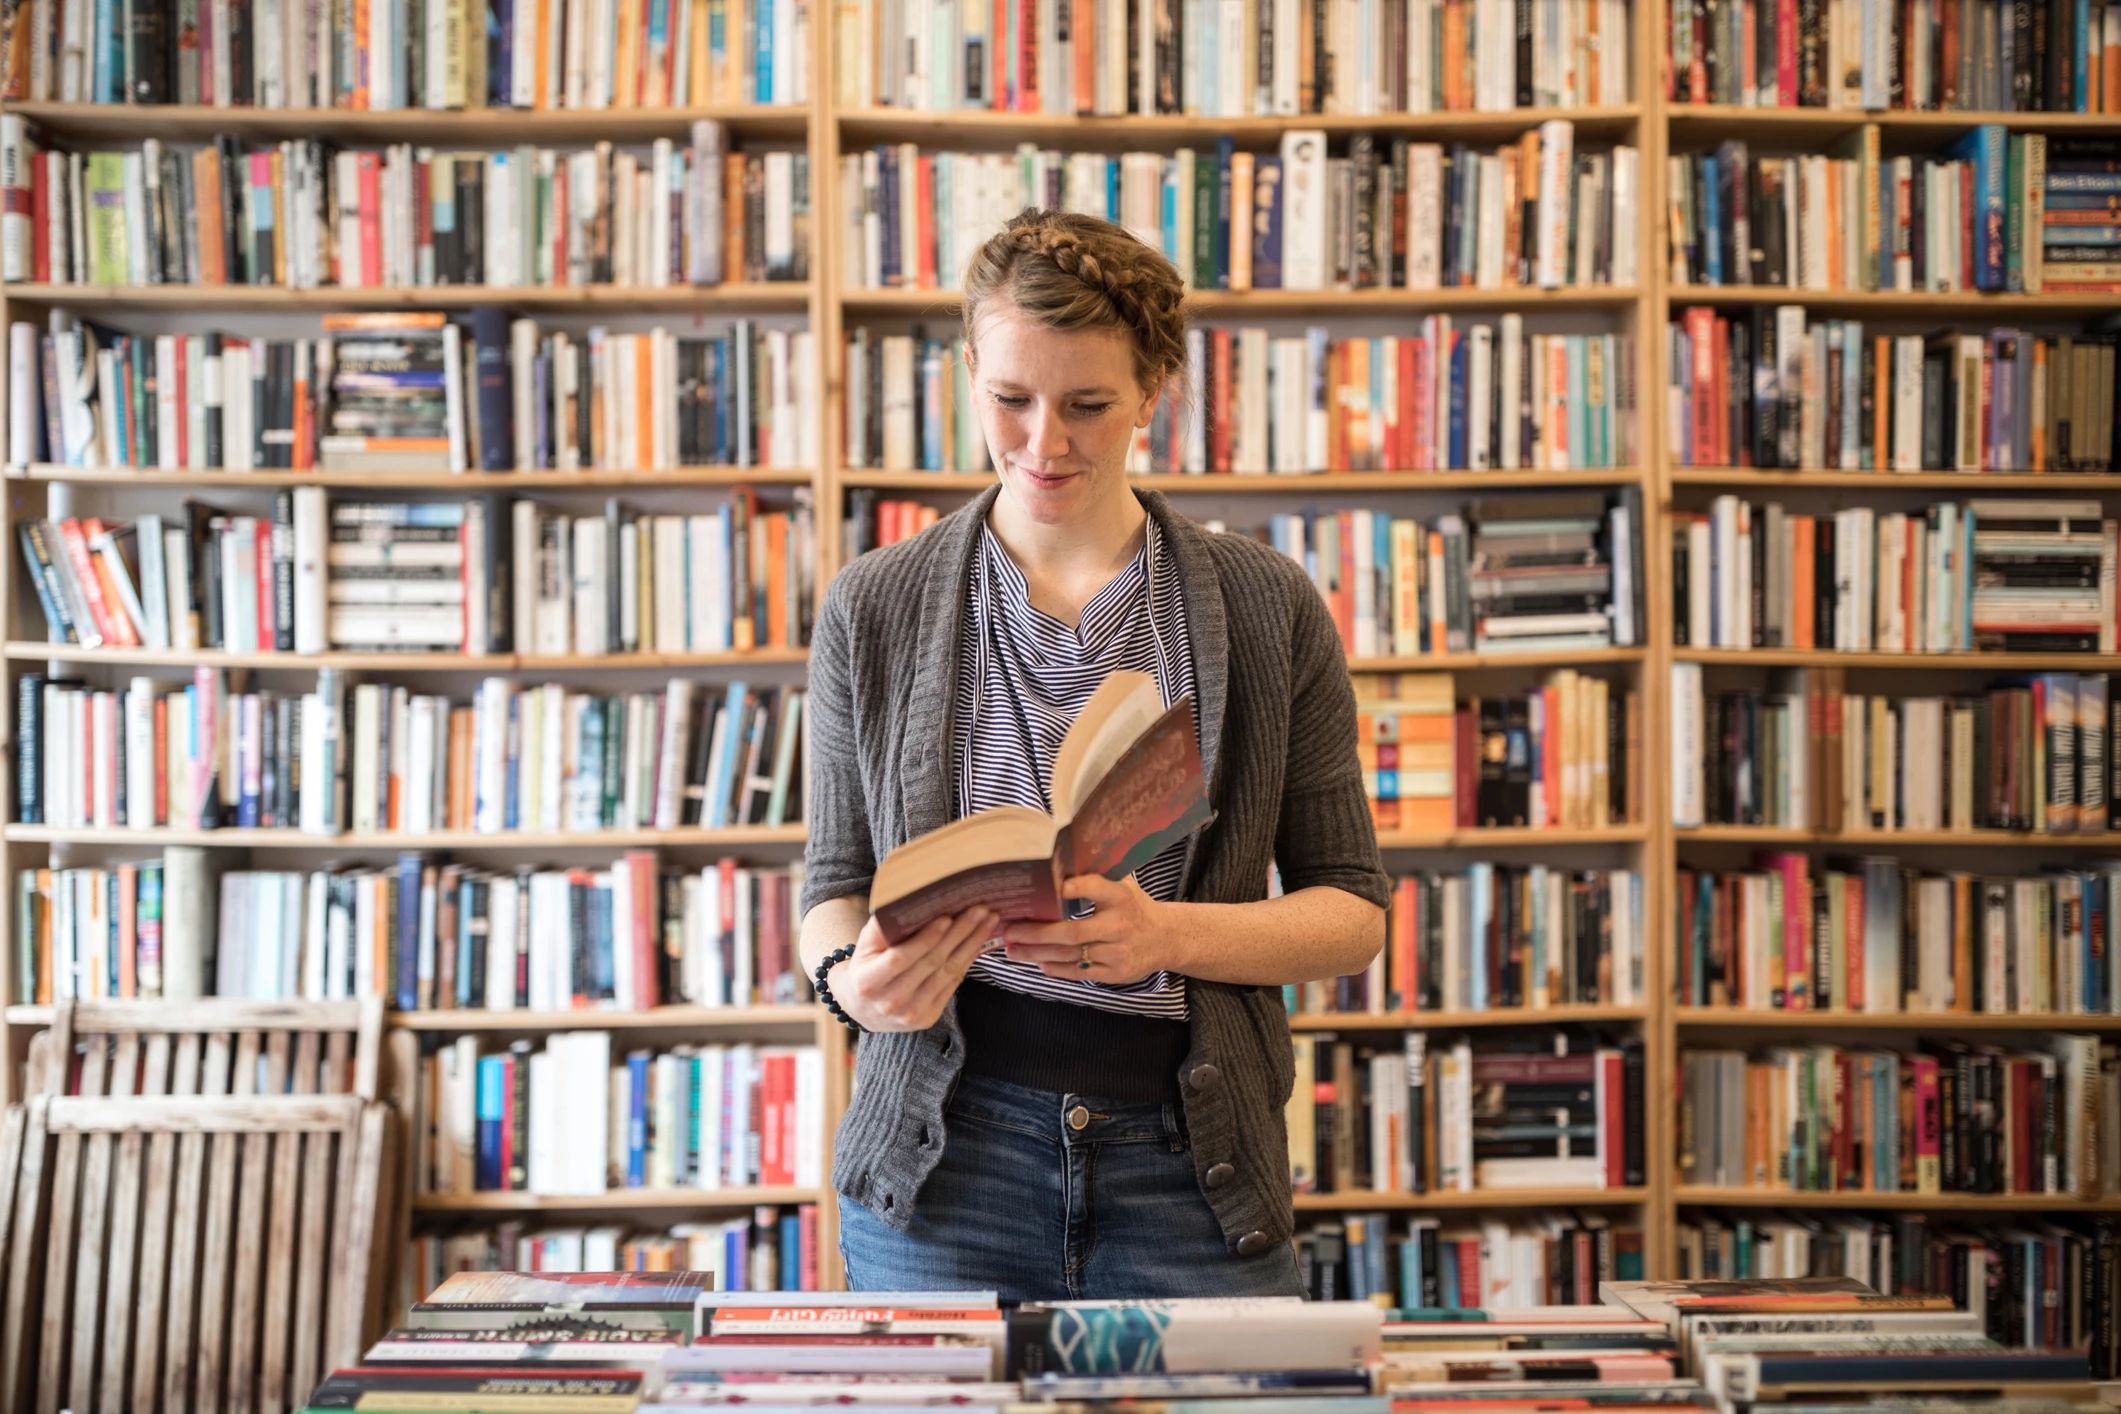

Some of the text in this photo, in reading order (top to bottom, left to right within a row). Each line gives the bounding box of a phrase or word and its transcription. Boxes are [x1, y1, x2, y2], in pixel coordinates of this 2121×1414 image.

[2048, 175, 2115, 190] Ben Elton
[767, 1309, 895, 1322] Funny Girl
[473, 1329, 669, 1342] ZADIE SMITH
